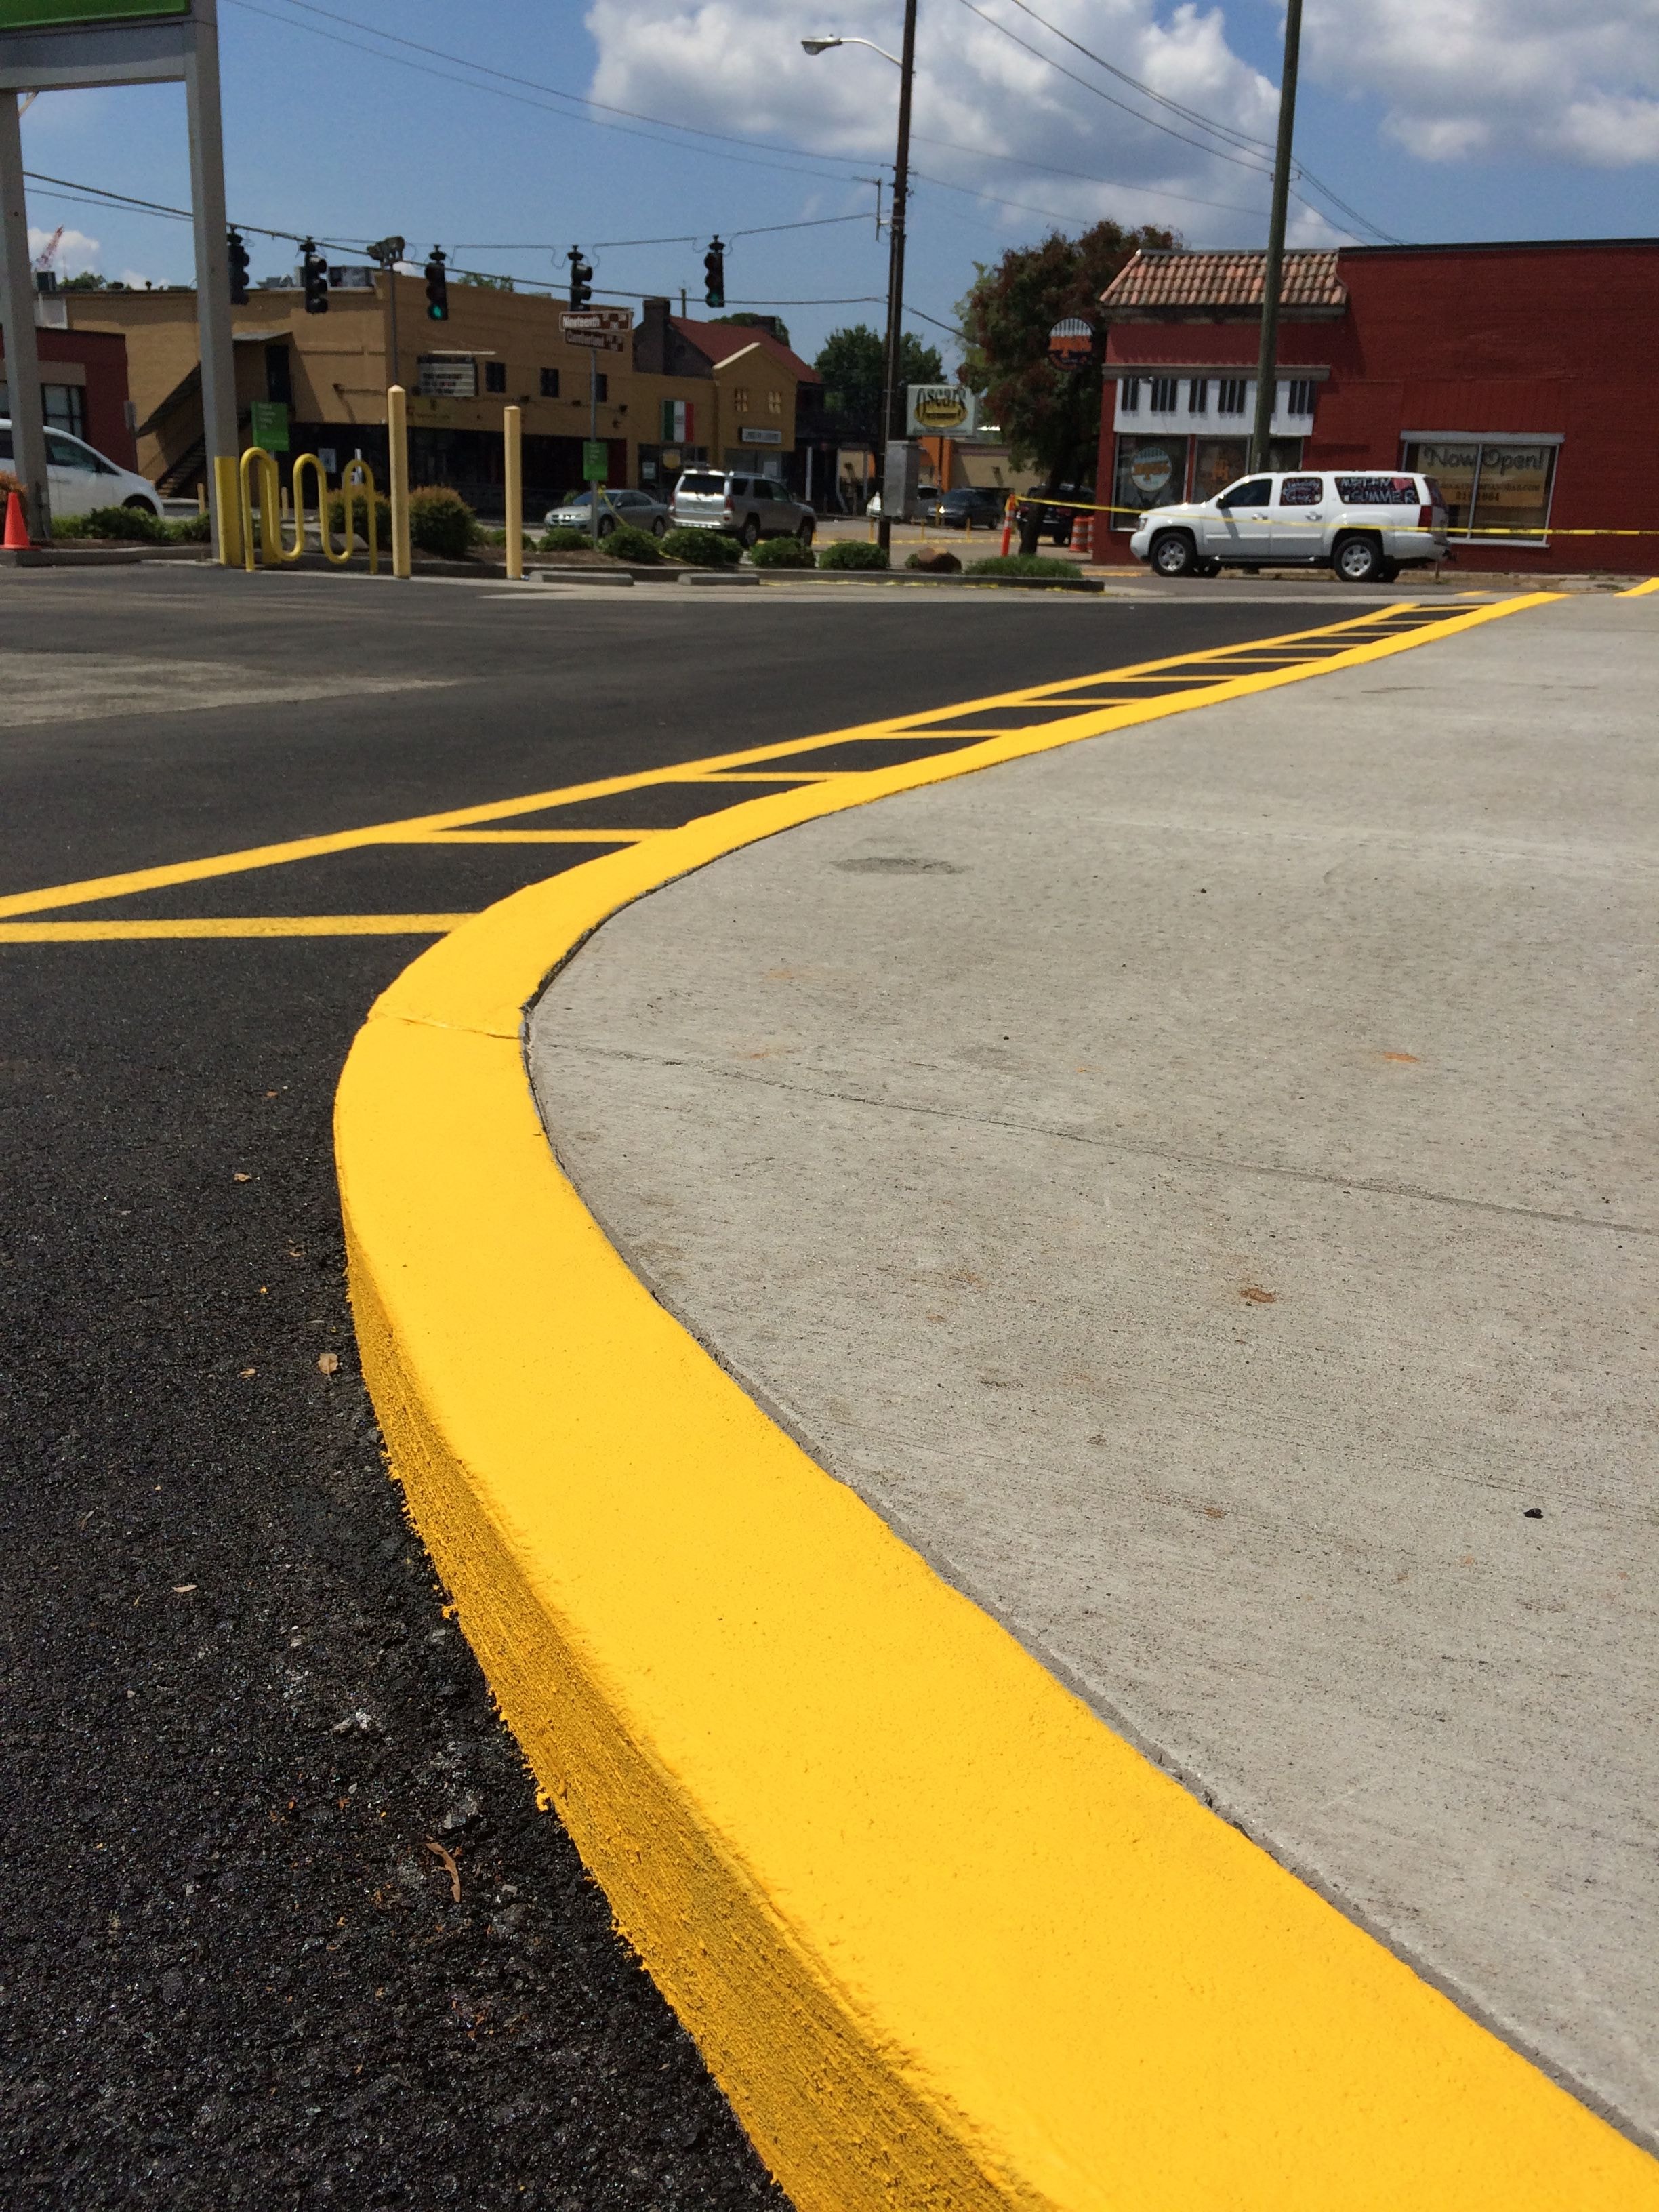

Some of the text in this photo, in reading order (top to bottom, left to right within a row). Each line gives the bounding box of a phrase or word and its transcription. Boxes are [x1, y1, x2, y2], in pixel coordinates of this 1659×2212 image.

[1424, 446, 1546, 476] Now Open!
[1351, 489, 1415, 504] SUMMER
